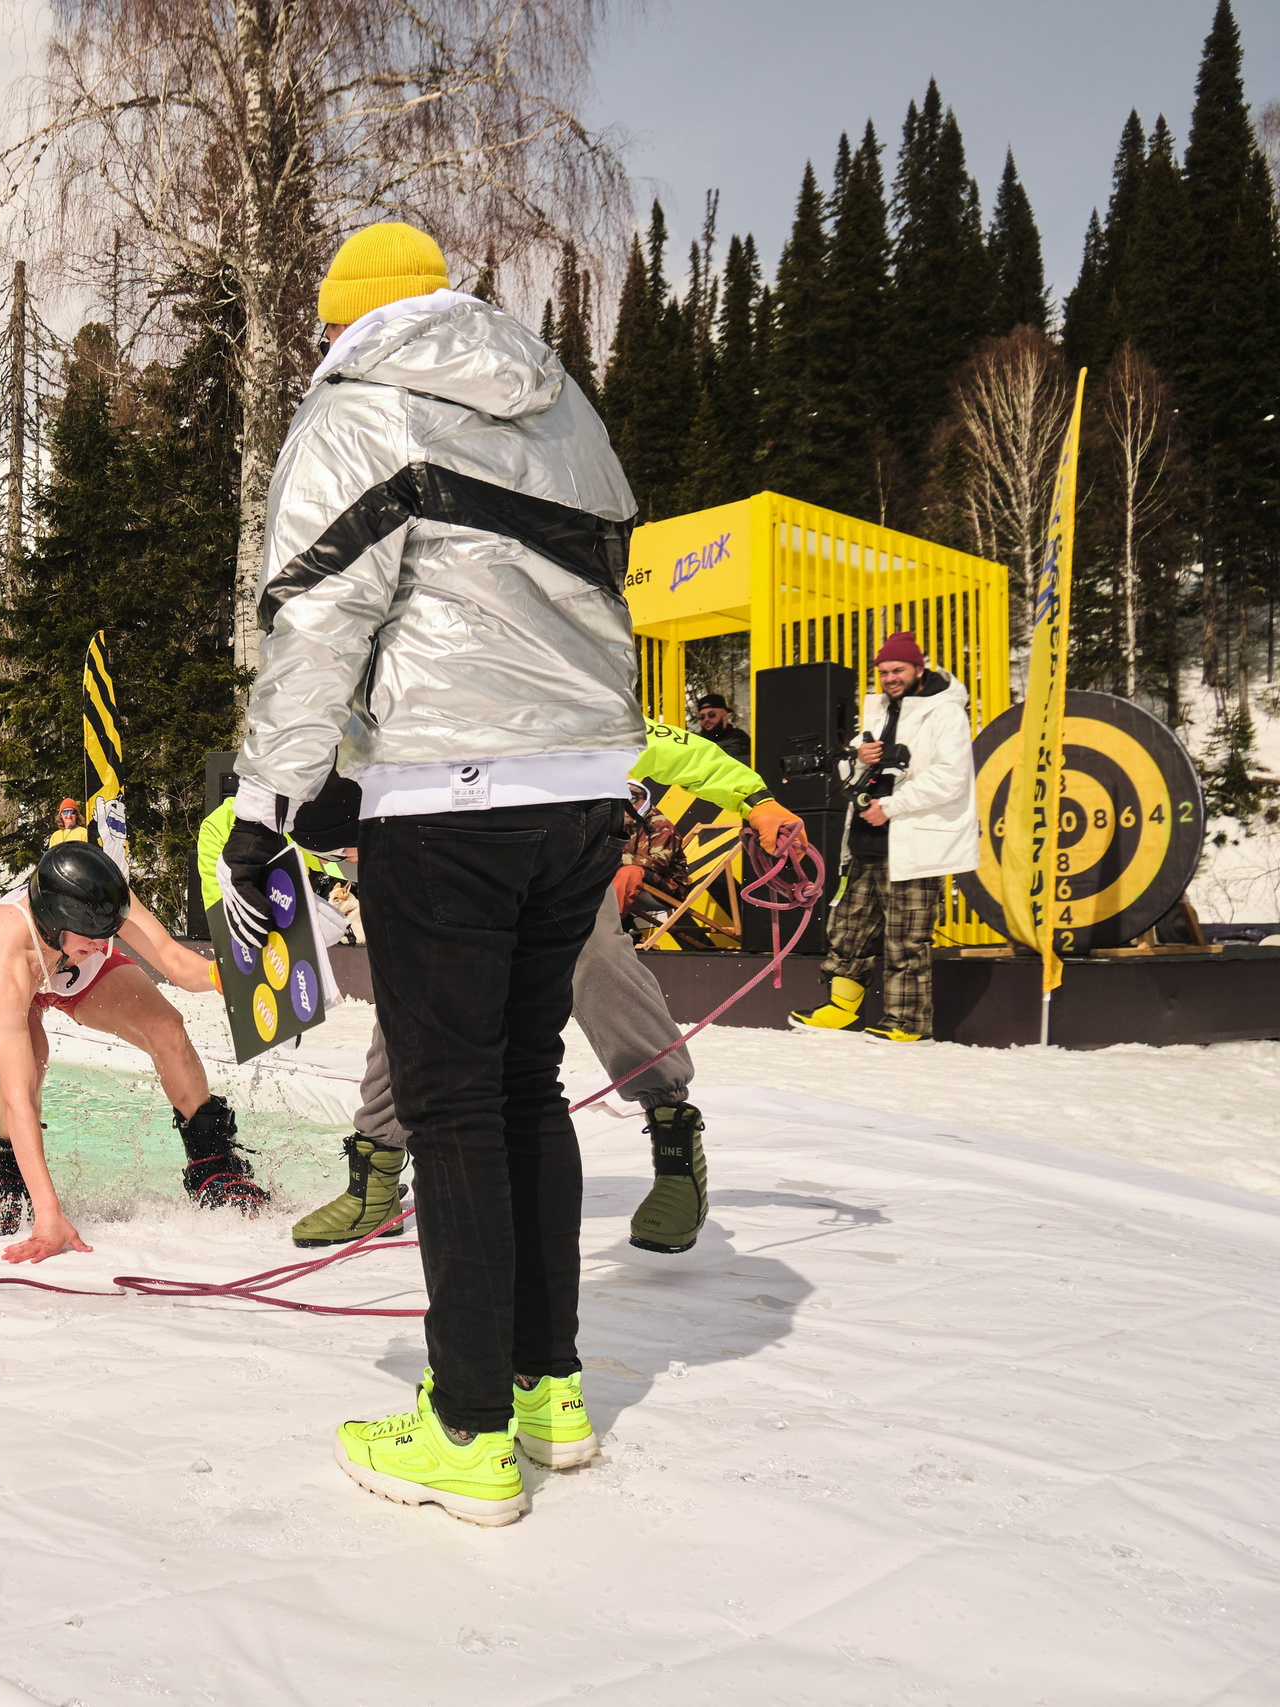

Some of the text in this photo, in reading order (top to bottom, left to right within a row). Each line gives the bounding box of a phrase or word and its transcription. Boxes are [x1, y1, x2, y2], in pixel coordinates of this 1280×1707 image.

[669, 532, 731, 592] ДВИЖ
[1093, 808, 1109, 829] 8
[1119, 805, 1137, 828] 6
[1148, 803, 1166, 825] 4
[1178, 801, 1195, 823] 2
[1056, 852, 1071, 873] 8
[1057, 878, 1072, 900] 6
[1059, 905, 1074, 925] 4
[1060, 930, 1075, 952] 2
[660, 1145, 683, 1157] LINE
[643, 1218, 662, 1228] LINE
[561, 1398, 584, 1412] FILA
[395, 1434, 413, 1446] FILA
